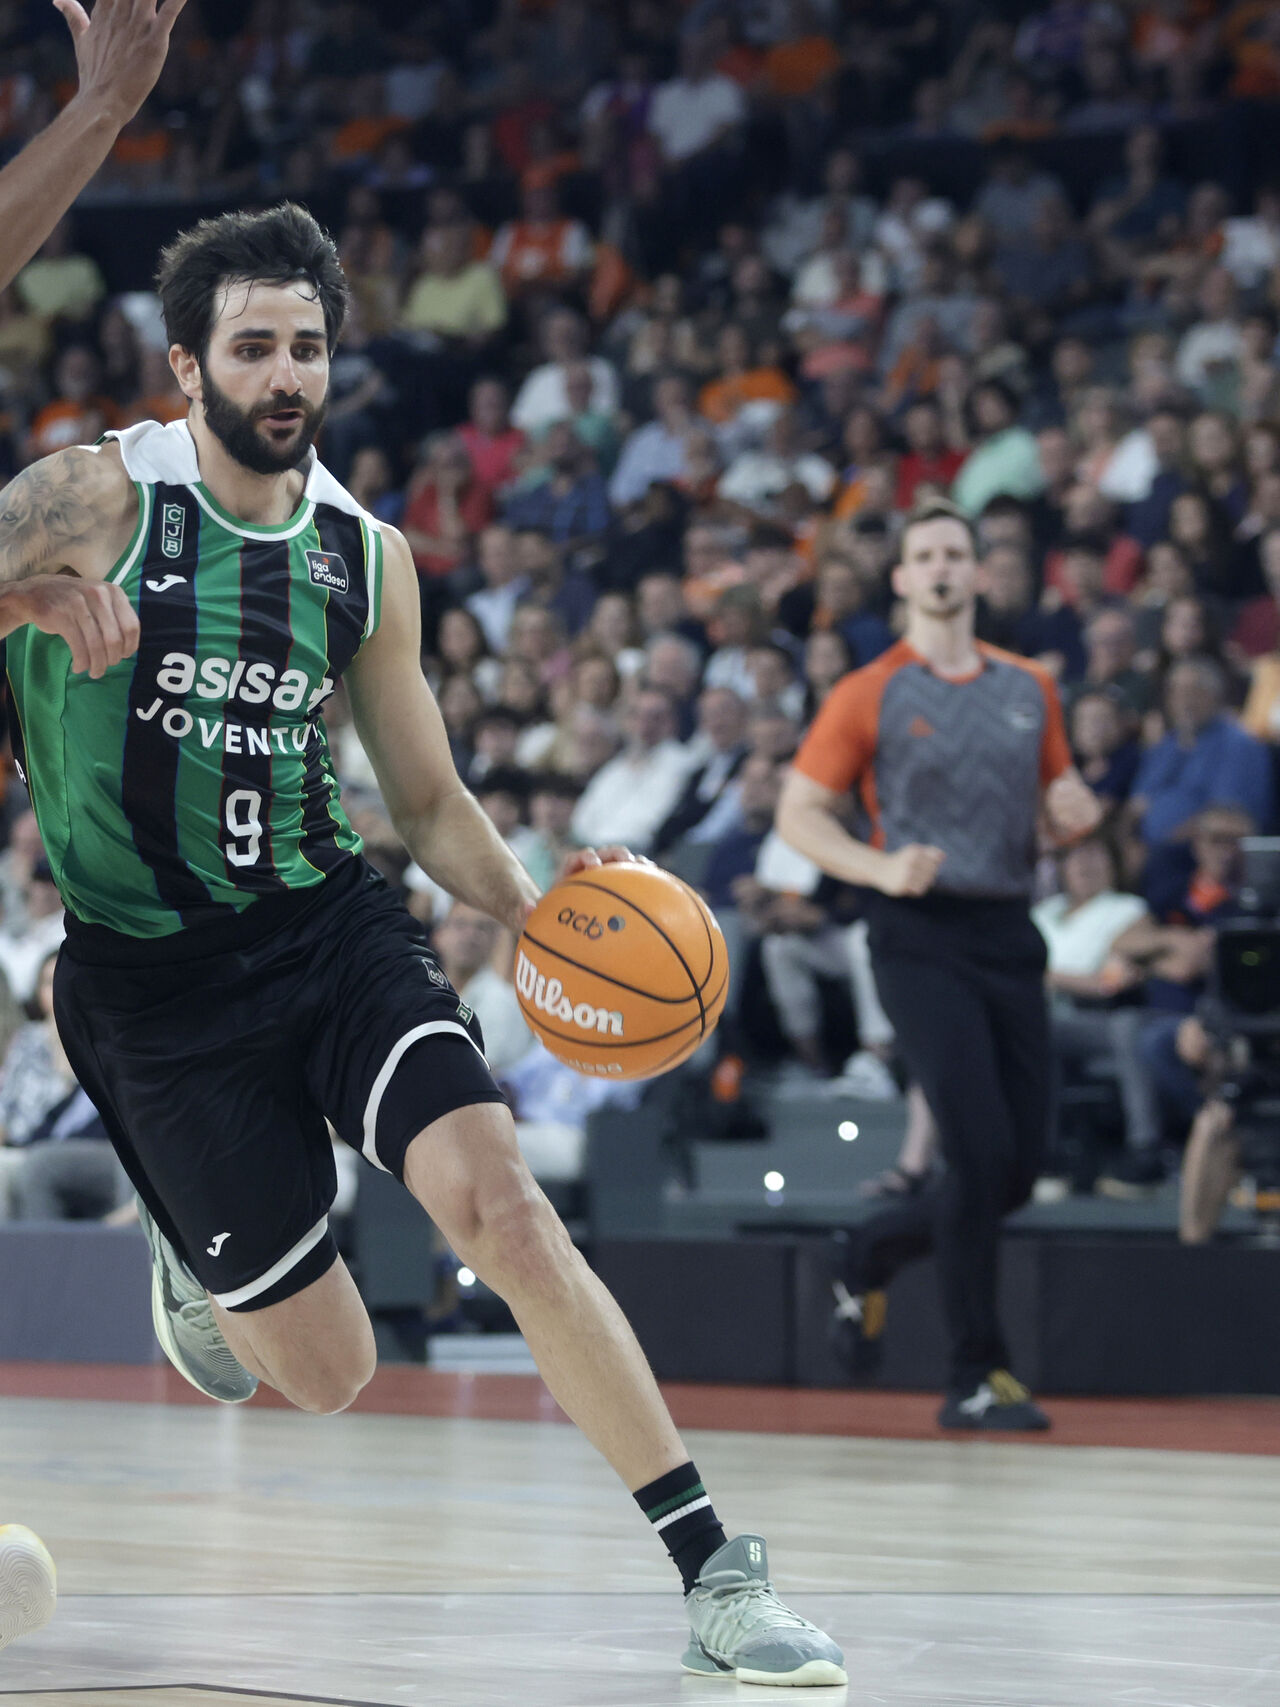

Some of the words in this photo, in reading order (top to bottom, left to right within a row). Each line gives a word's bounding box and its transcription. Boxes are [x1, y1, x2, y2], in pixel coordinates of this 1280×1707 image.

[311, 559, 329, 573] liga
[313, 571, 346, 588] endesa
[136, 697, 320, 756] JOVENTU
[225, 789, 263, 868] 9
[557, 906, 605, 942] acb
[516, 948, 625, 1036] Wilson
